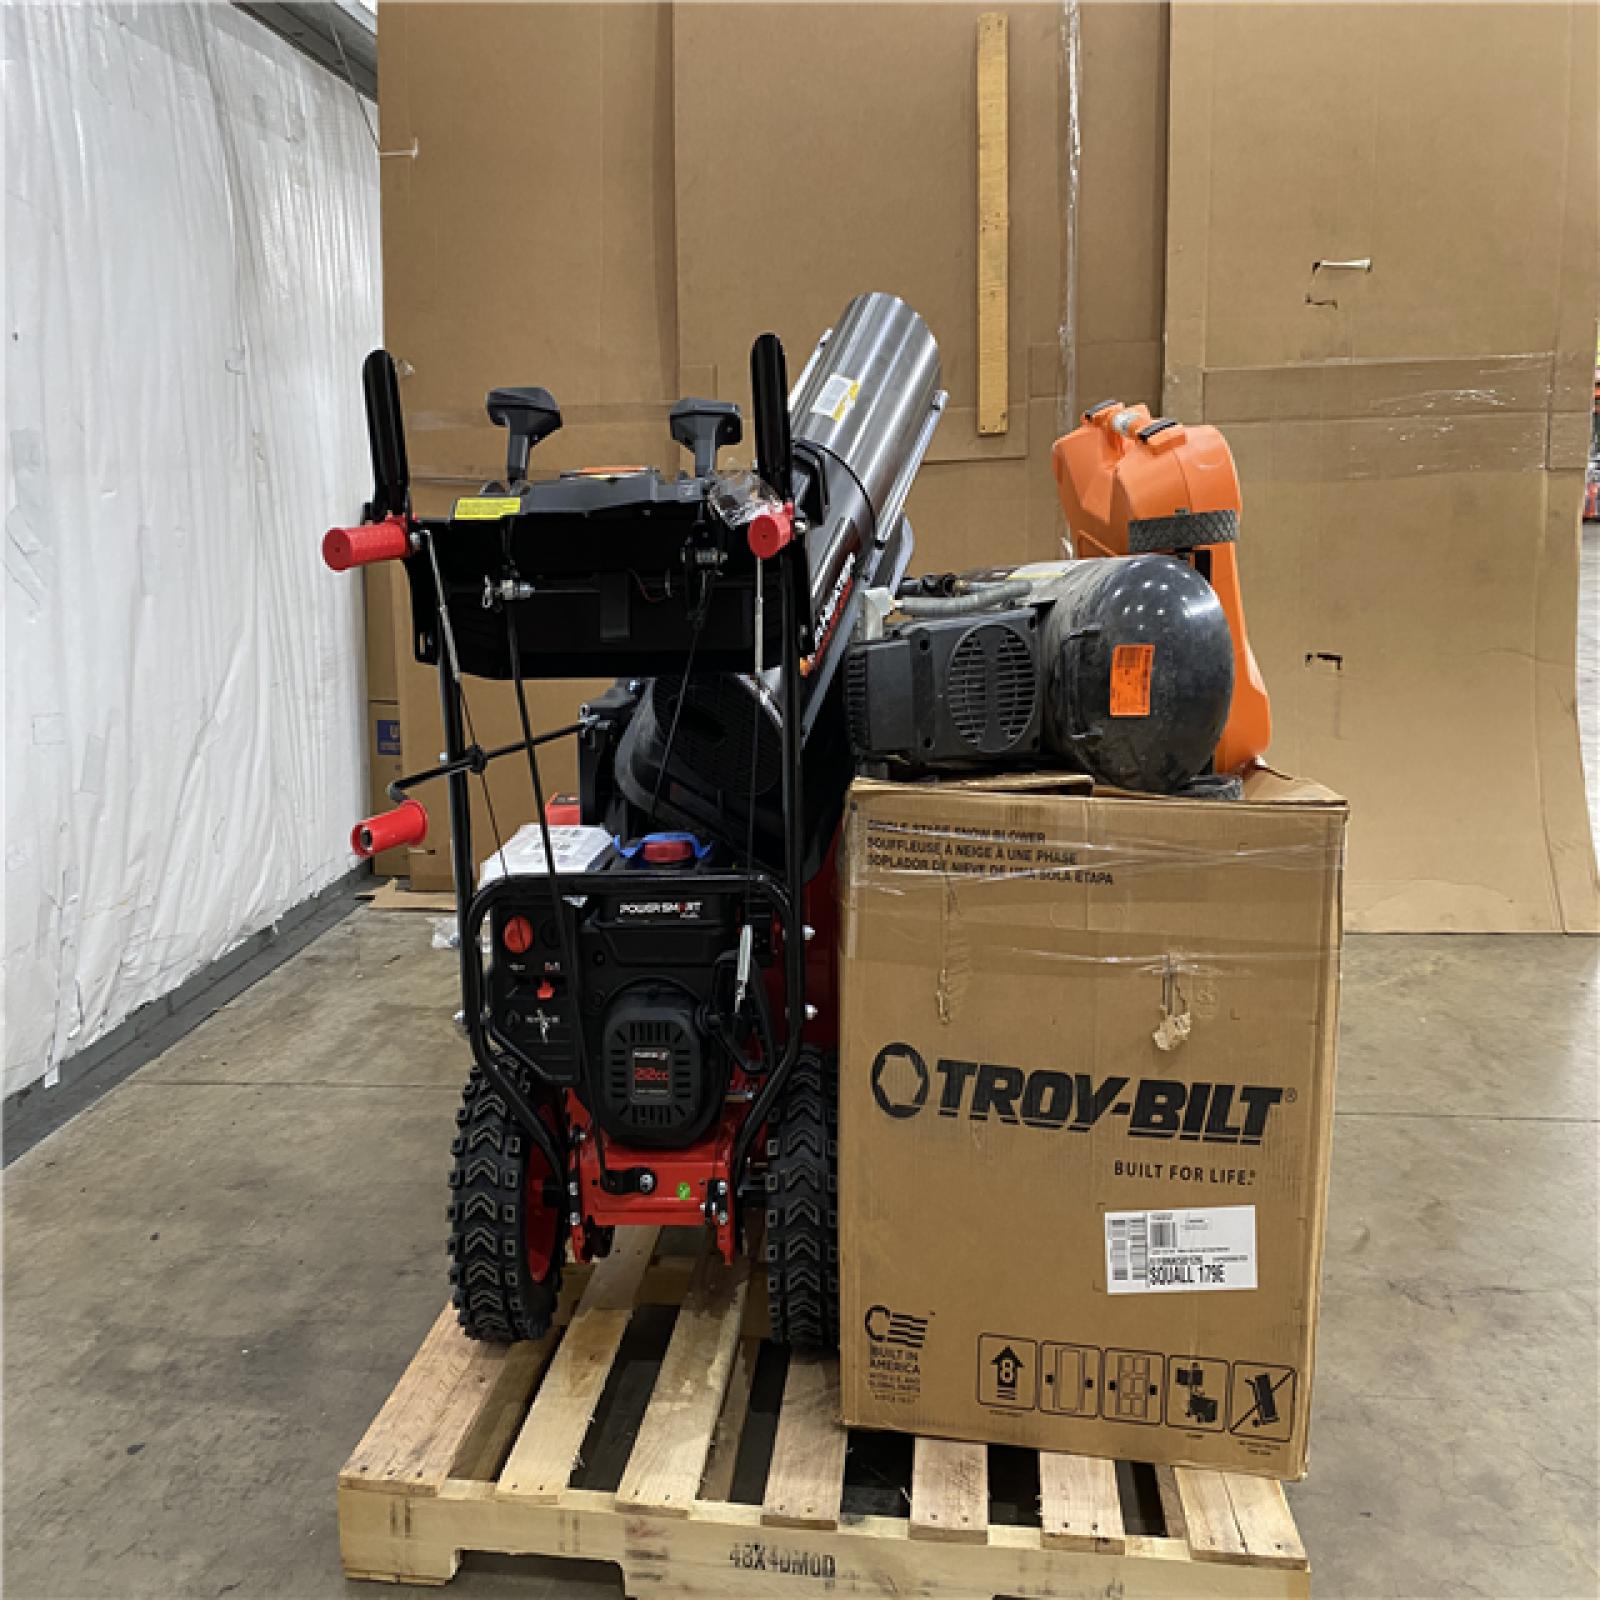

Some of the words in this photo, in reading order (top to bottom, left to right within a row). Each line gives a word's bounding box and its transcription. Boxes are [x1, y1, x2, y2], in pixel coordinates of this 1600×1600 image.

[937, 1060, 1283, 1144] TROY-BILT
[1114, 1160, 1163, 1179] BUILT
[1170, 1165, 1203, 1182] FOR
[1150, 1265, 1195, 1285] SQUALL
